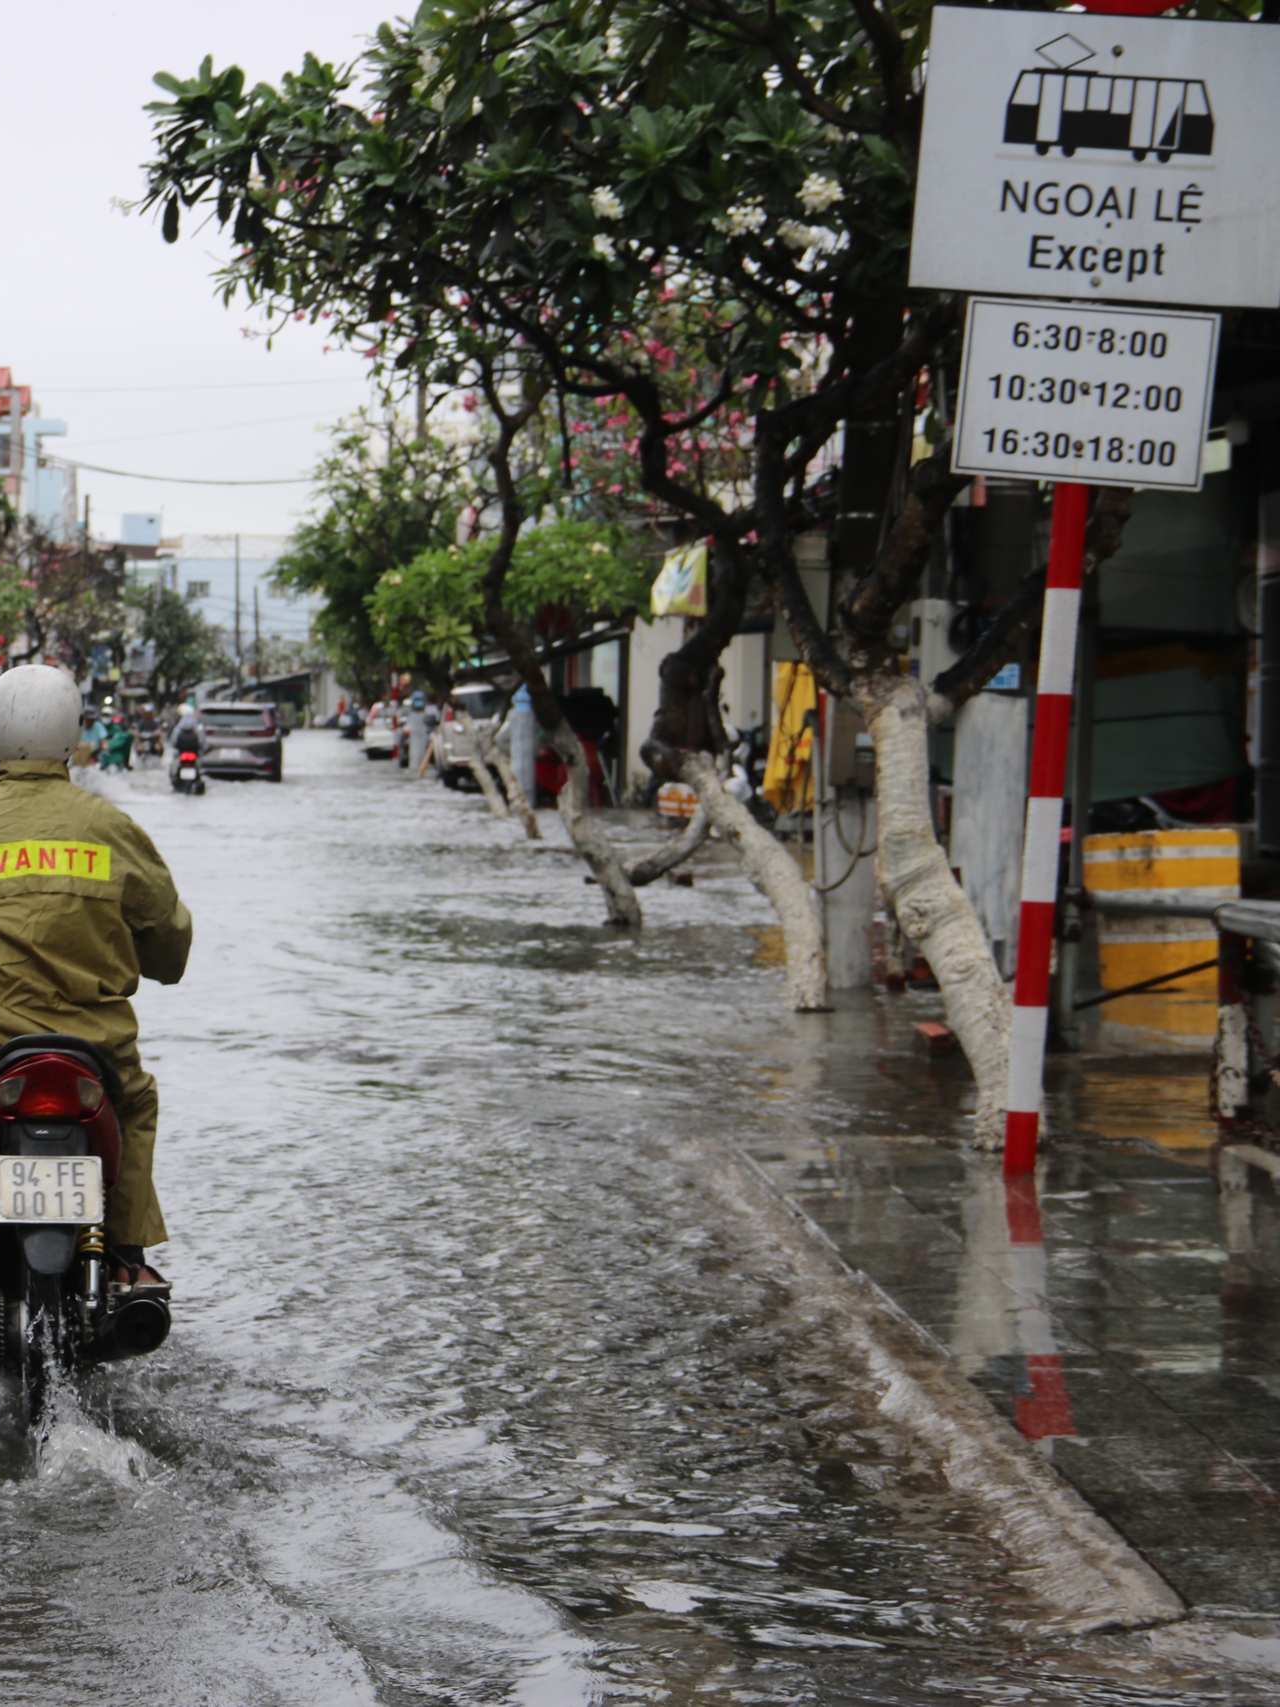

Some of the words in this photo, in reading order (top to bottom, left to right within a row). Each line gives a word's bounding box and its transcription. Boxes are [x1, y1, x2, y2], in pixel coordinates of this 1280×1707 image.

[1000, 180, 1137, 229] NGOẠI
[1154, 183, 1205, 234] LỆ
[1028, 235, 1165, 283] Except
[1012, 322, 1168, 359] 6:30-8:00
[13, 1190, 85, 1217] 0013
